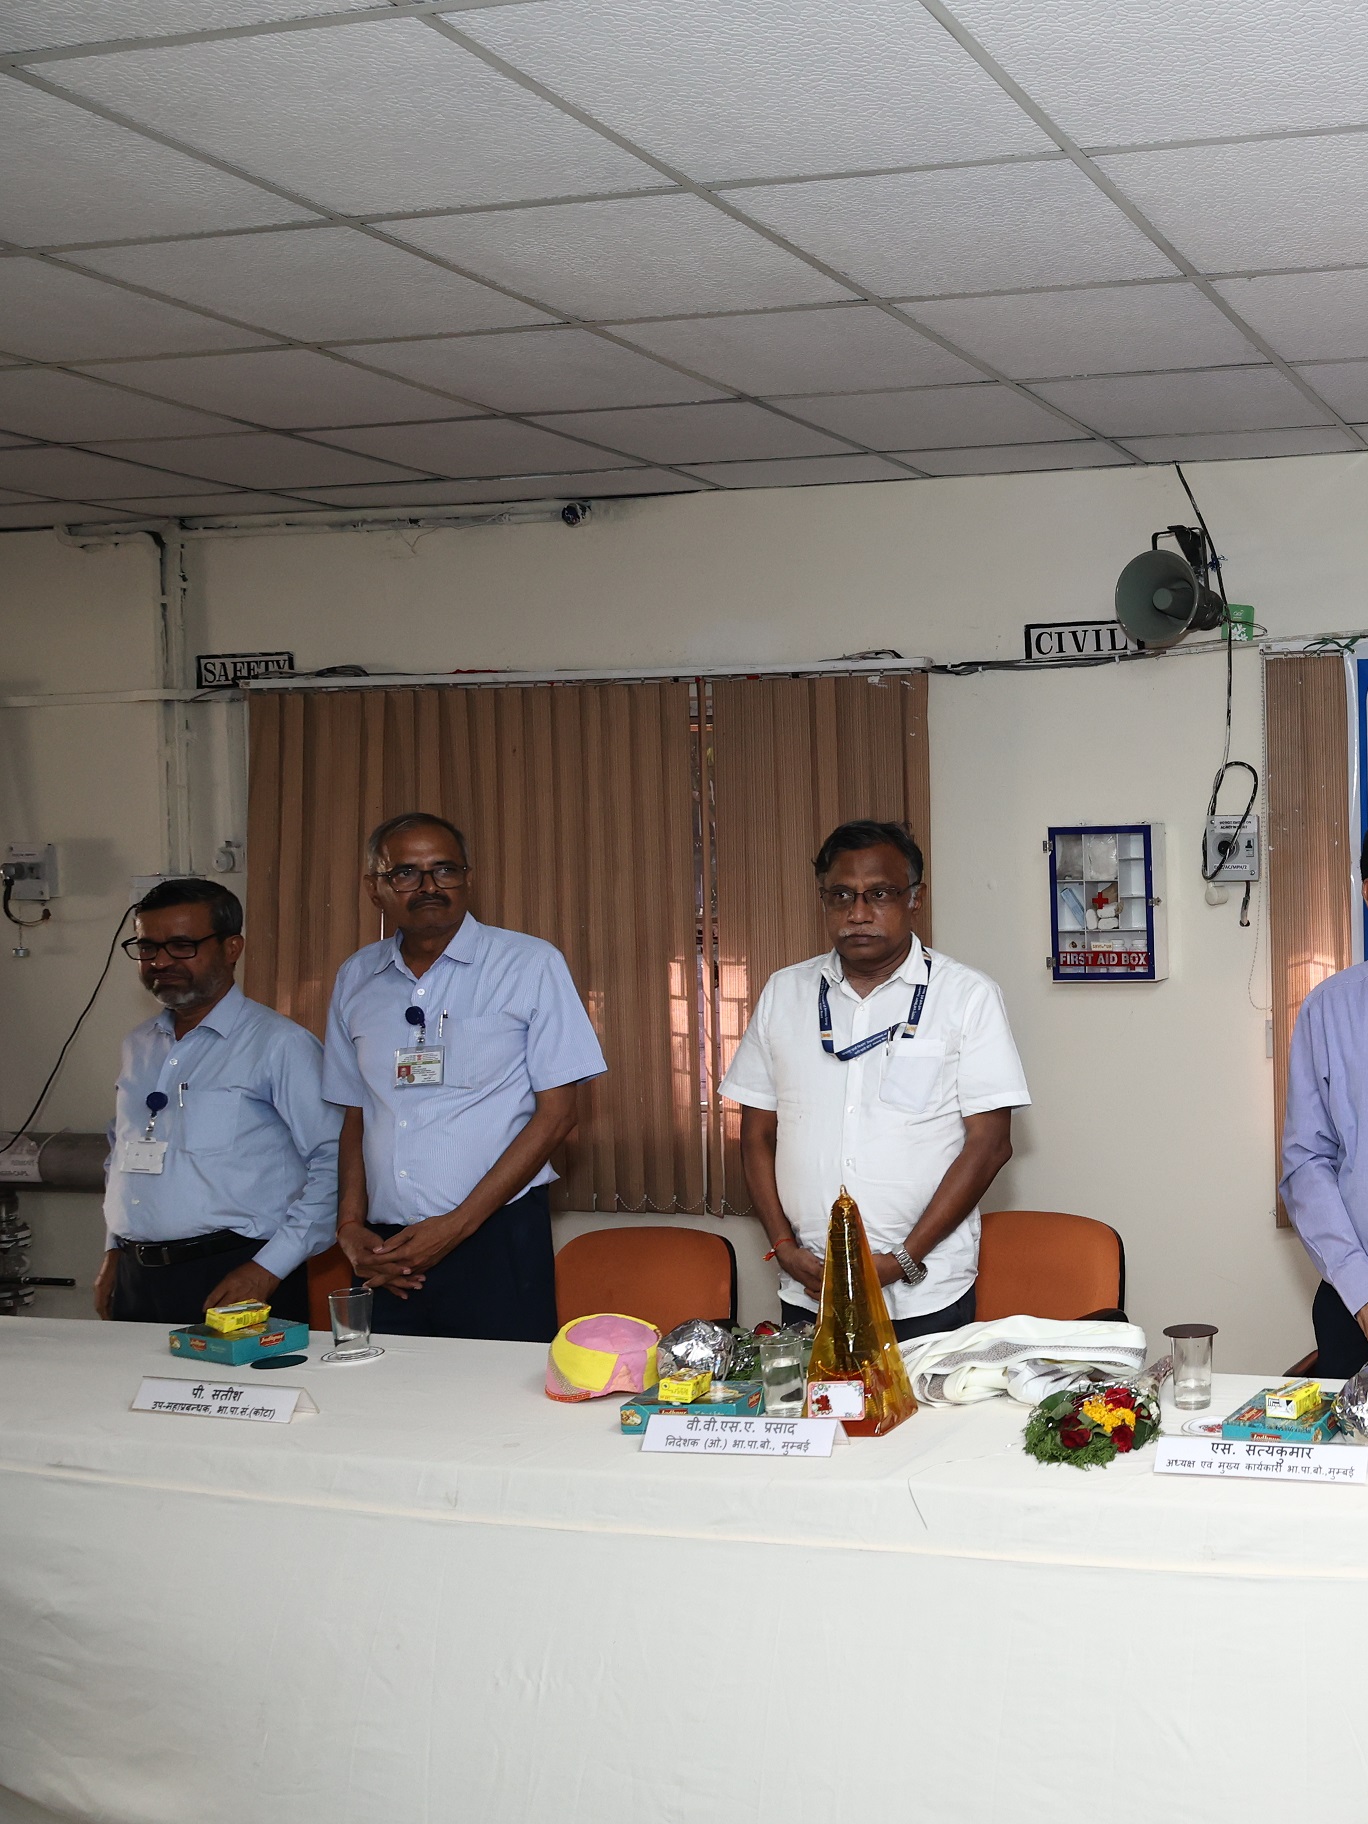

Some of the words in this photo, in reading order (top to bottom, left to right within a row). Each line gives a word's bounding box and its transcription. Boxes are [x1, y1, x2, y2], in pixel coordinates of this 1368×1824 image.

[1034, 627, 1128, 656] CIVIL
[1059, 952, 1094, 965] FIRST
[1096, 952, 1119, 965] AID
[1121, 952, 1147, 965] BOX
[212, 1386, 244, 1402] सतीश
[764, 1421, 798, 1435] प्रसाद
[664, 1435, 700, 1448] निदेशक
[1210, 1442, 1236, 1456] एस.
[1245, 1443, 1315, 1465] सत्यकुमार
[1165, 1458, 1196, 1470] अध्यक्ष
[1200, 1458, 1214, 1470] एवं
[1217, 1460, 1240, 1474] मुख्य
